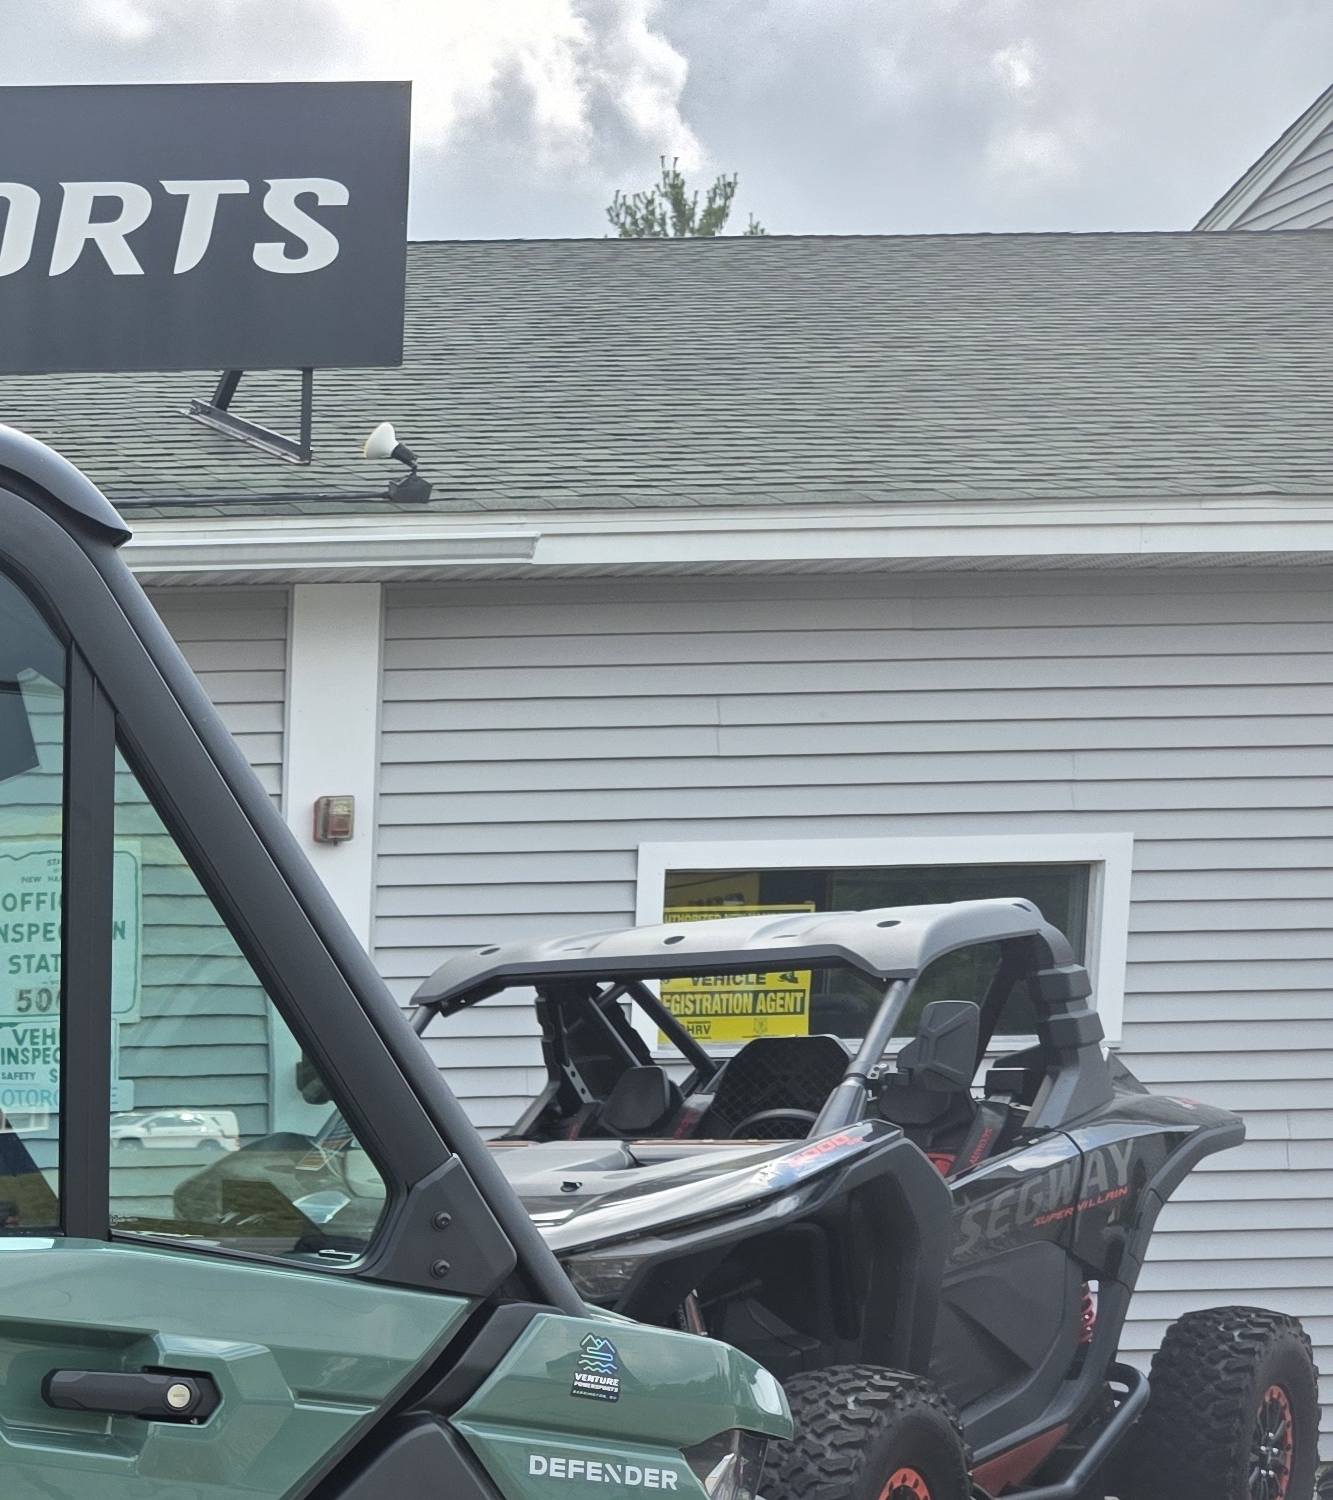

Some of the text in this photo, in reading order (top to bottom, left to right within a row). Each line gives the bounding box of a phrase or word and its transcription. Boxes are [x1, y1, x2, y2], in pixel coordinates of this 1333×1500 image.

[1, 892, 62, 912] OFFI
[8, 954, 61, 974] STAT
[691, 974, 766, 987] VEHICLE
[16, 988, 61, 1012] 50
[662, 991, 804, 1015] EGISTRATION AGENT
[684, 1024, 712, 1035] HRV
[0, 1047, 60, 1065] INSPEC
[1, 1072, 36, 1080] SAFETY
[952, 1138, 1135, 1260] SEGWAY
[1033, 1186, 1129, 1227] SUPER VILLAIN
[574, 1372, 620, 1387] VENTURE
[528, 1454, 679, 1490] DEFENDER
